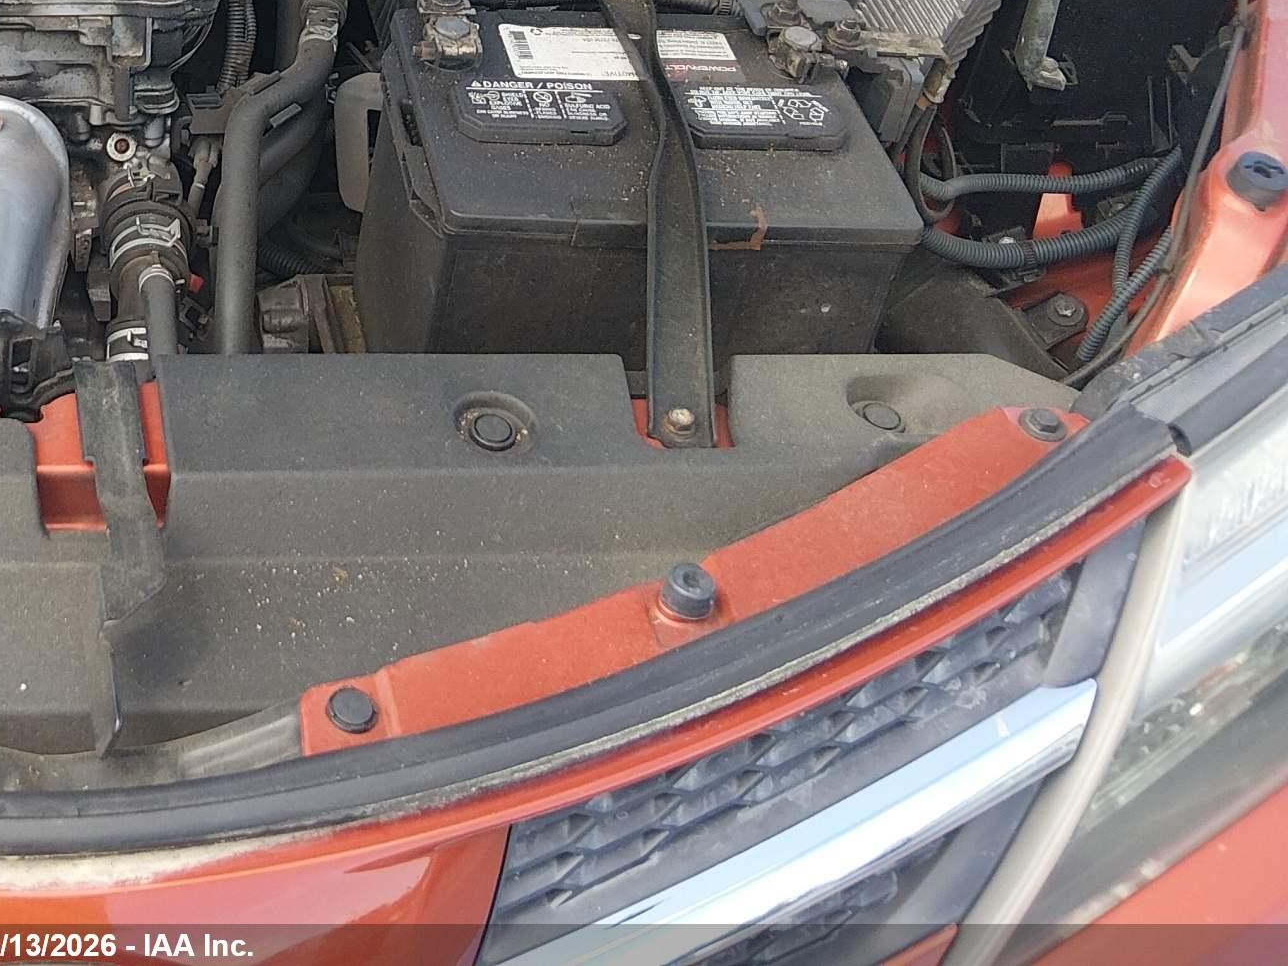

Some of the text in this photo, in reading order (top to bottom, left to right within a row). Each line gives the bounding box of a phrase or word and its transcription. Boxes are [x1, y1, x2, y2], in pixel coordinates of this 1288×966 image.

[665, 64, 736, 72] POWERVOLT
[483, 80, 534, 89] DANGER
[546, 81, 593, 90] POISON
